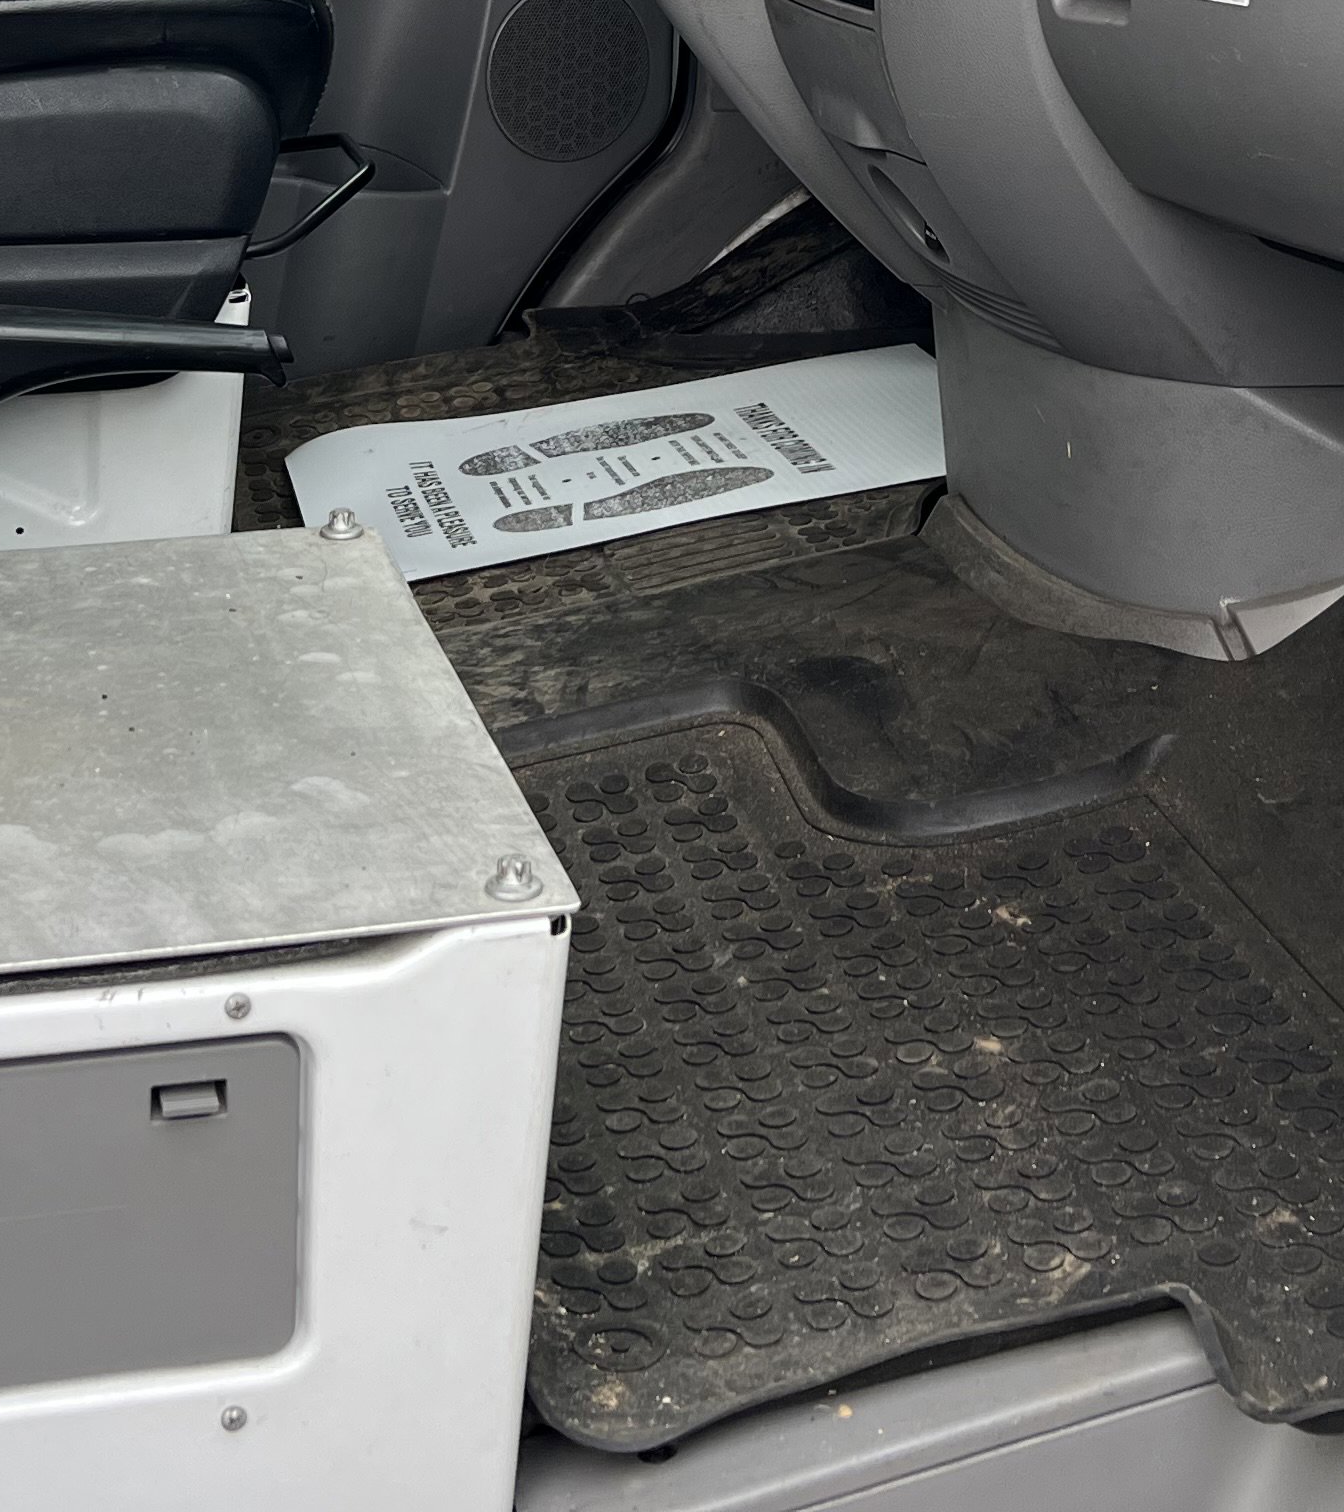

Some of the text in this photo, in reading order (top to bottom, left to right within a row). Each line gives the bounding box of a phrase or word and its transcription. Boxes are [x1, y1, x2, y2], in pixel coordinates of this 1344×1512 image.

[733, 403, 786, 430] THANKS
[757, 427, 799, 443] FOR
[770, 440, 827, 466] COMING
[797, 463, 837, 474] IN
[386, 485, 433, 538] TO SERVE YOU
[409, 461, 477, 548] IT HAS BEEN A PLEASURE
